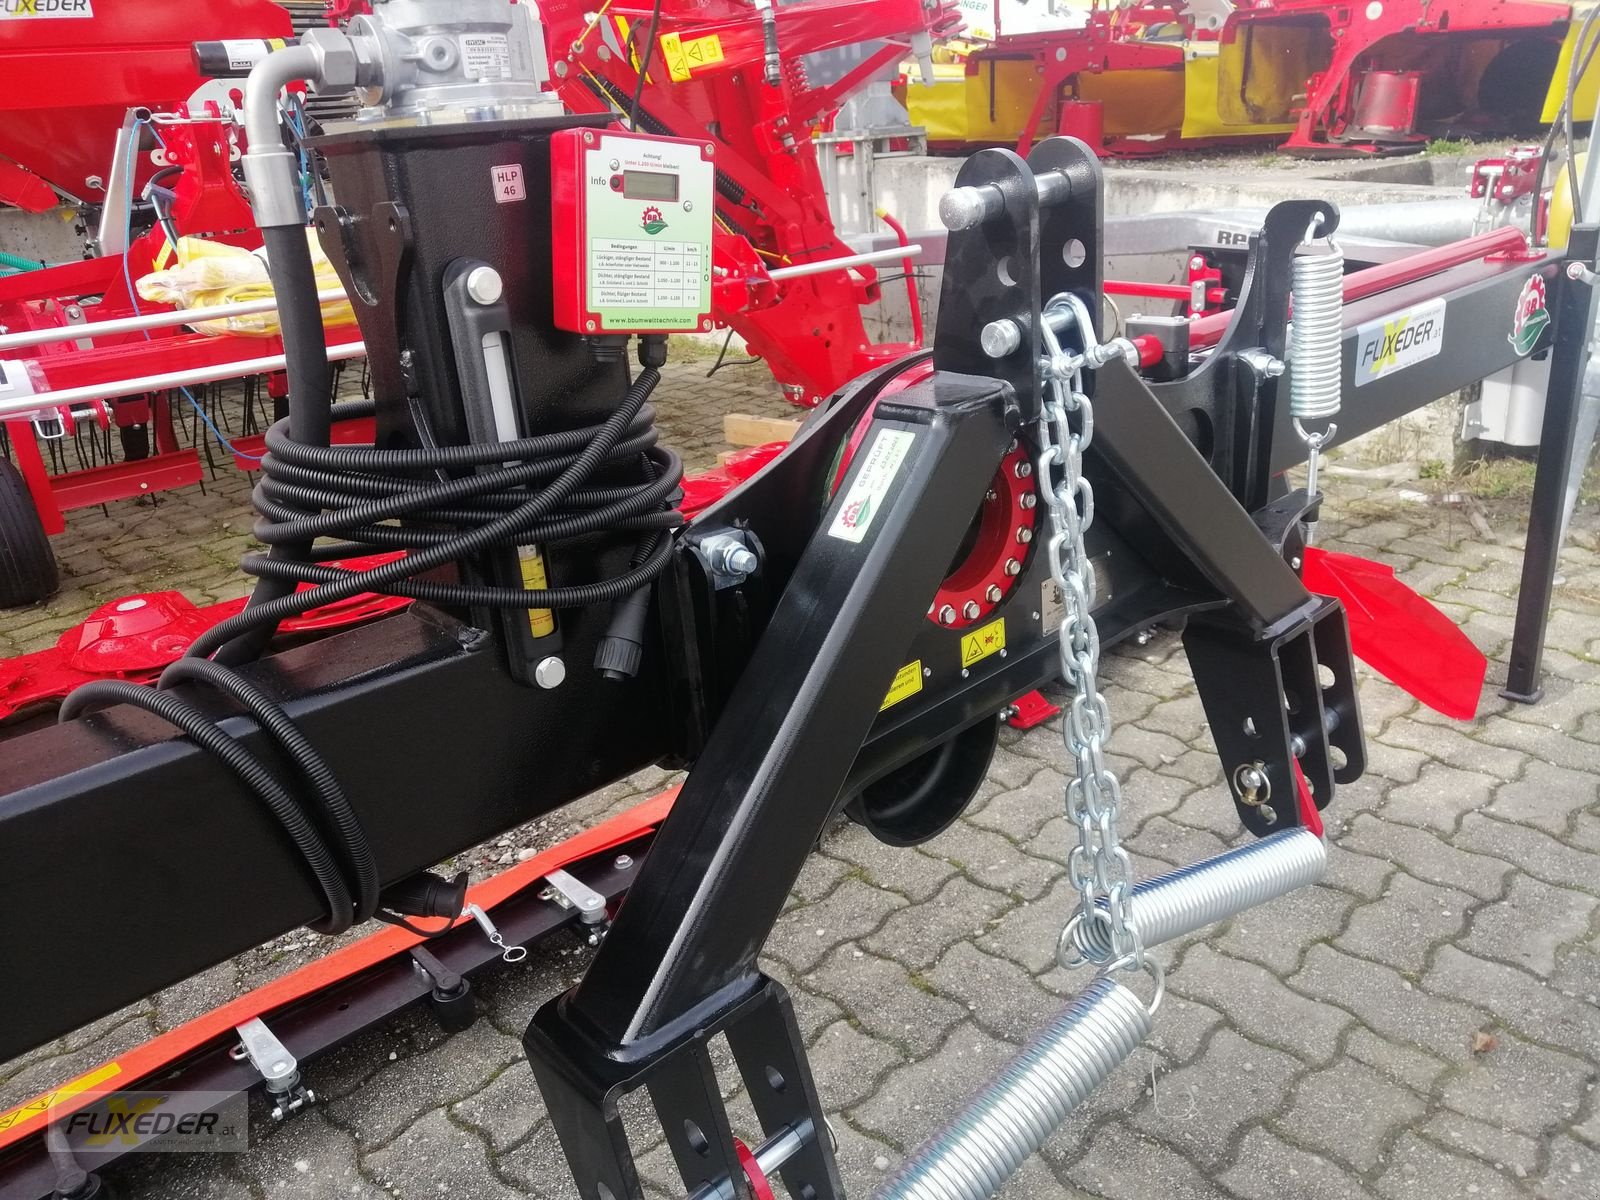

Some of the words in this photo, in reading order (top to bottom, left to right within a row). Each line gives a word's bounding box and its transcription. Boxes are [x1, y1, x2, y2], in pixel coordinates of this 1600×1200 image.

[0, 0, 86, 12] LIXEDER
[959, 0, 988, 11] INGER
[497, 171, 517, 182] HLP
[591, 176, 606, 185] Info
[504, 185, 516, 195] 46
[858, 435, 888, 488] GEPRÜFT
[896, 667, 917, 681] stunden
